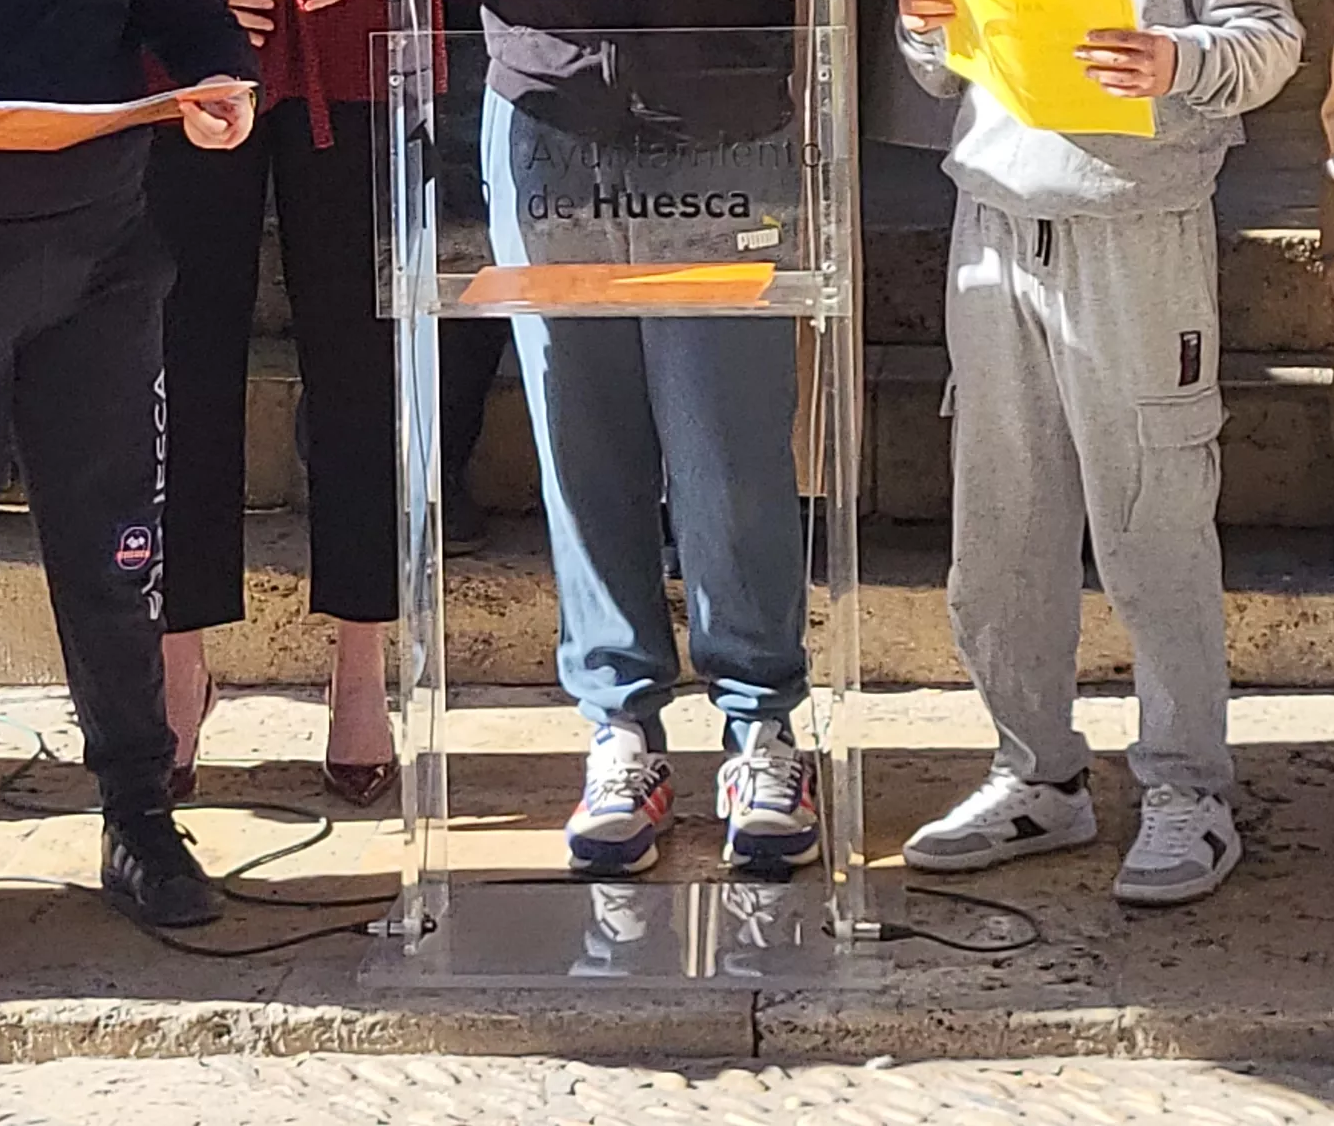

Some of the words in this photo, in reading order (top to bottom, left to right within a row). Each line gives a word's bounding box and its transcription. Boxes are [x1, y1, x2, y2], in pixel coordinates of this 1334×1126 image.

[526, 133, 822, 176] Ayuntamiento
[527, 184, 575, 220] de
[593, 183, 751, 220] Huesca
